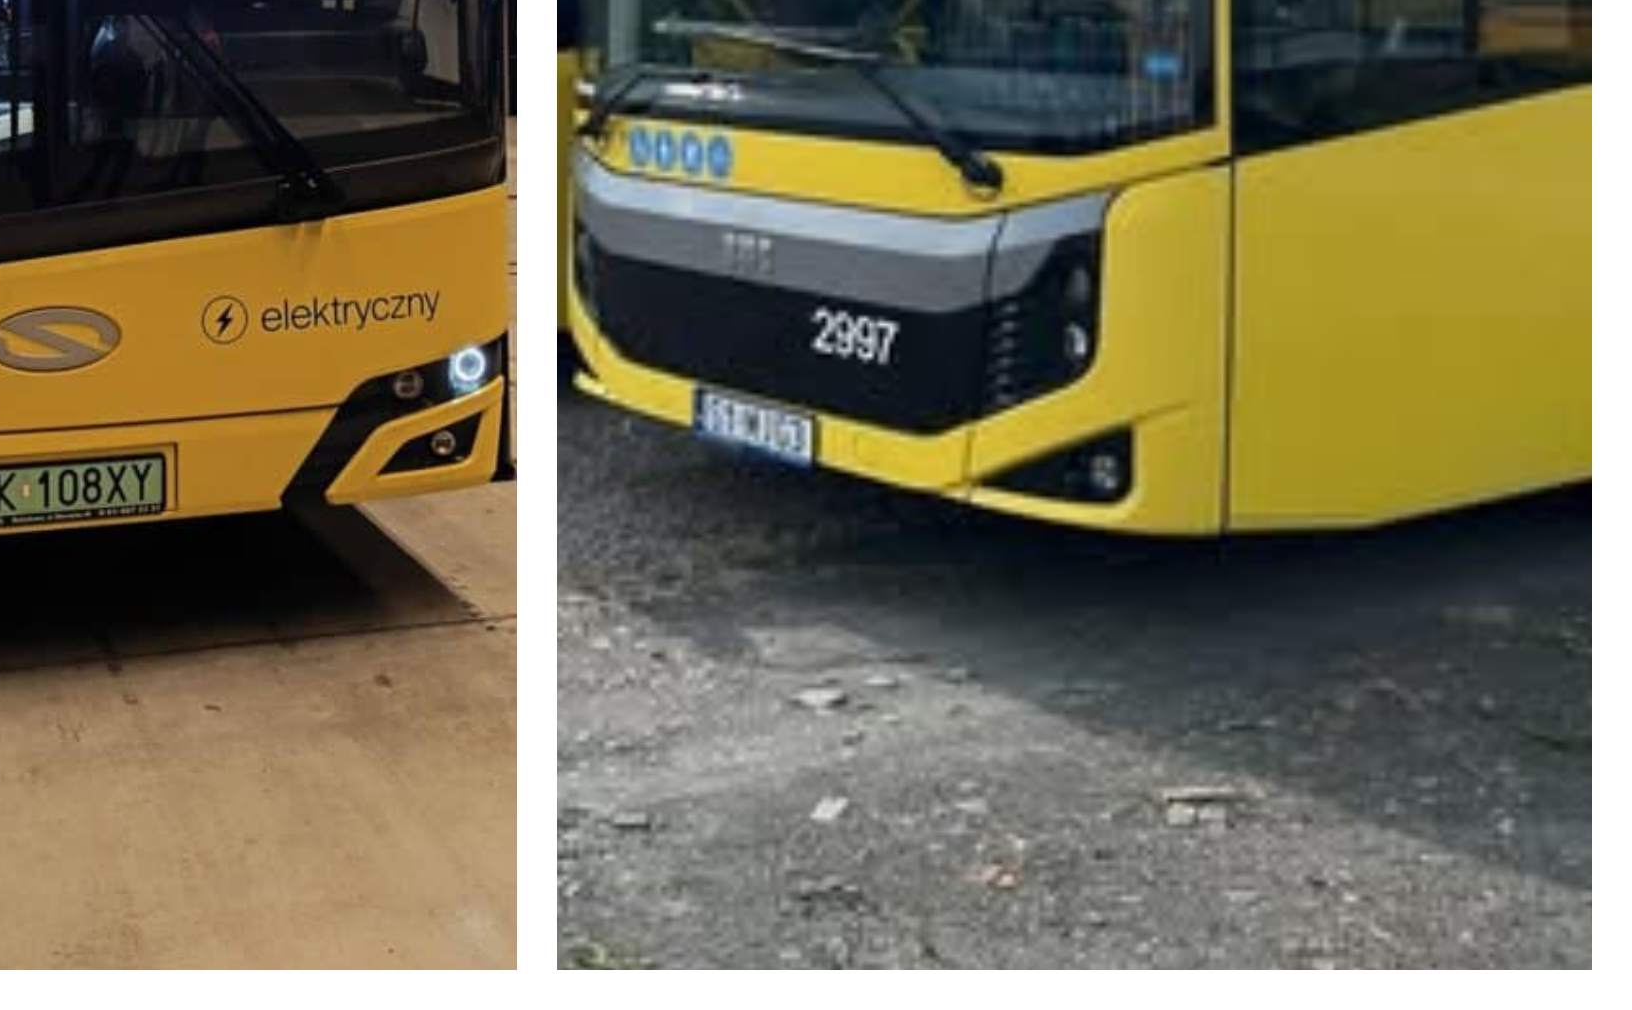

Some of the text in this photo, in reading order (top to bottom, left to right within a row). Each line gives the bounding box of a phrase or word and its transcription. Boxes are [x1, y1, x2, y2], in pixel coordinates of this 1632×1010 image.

[260, 290, 441, 333] elektryczny
[811, 307, 900, 366] 2997
[37, 462, 153, 508] 108XY
